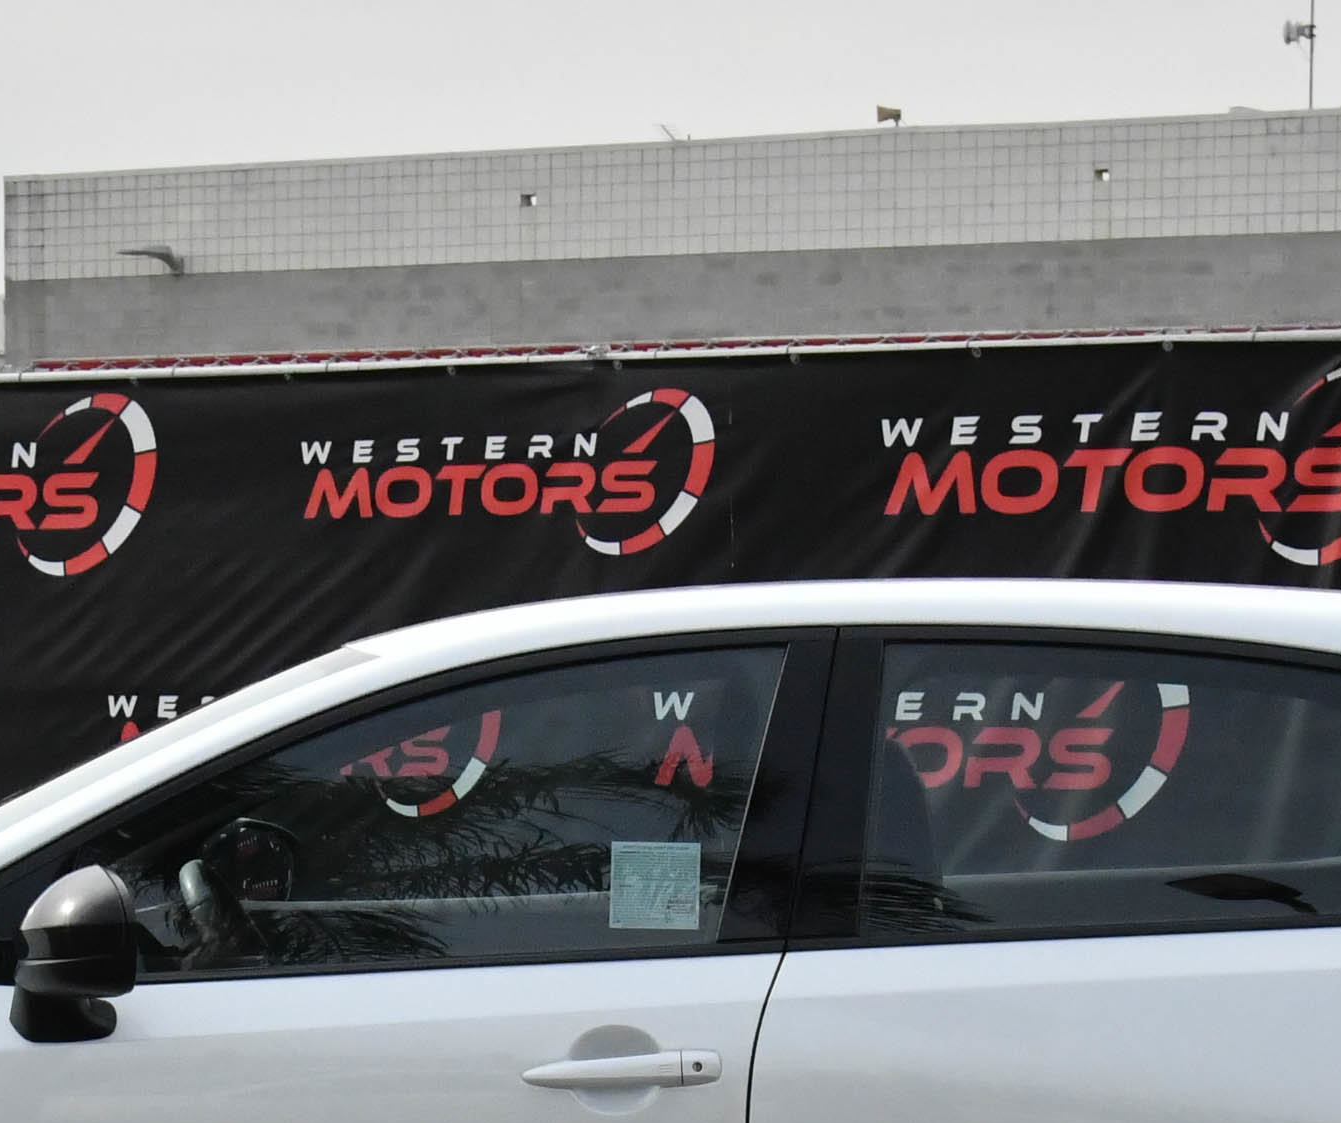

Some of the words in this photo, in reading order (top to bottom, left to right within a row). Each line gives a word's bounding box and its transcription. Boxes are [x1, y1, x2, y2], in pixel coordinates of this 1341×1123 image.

[881, 411, 1290, 448] WESTERN
[301, 433, 598, 465] WESTERN
[303, 460, 657, 519] MOTORS
